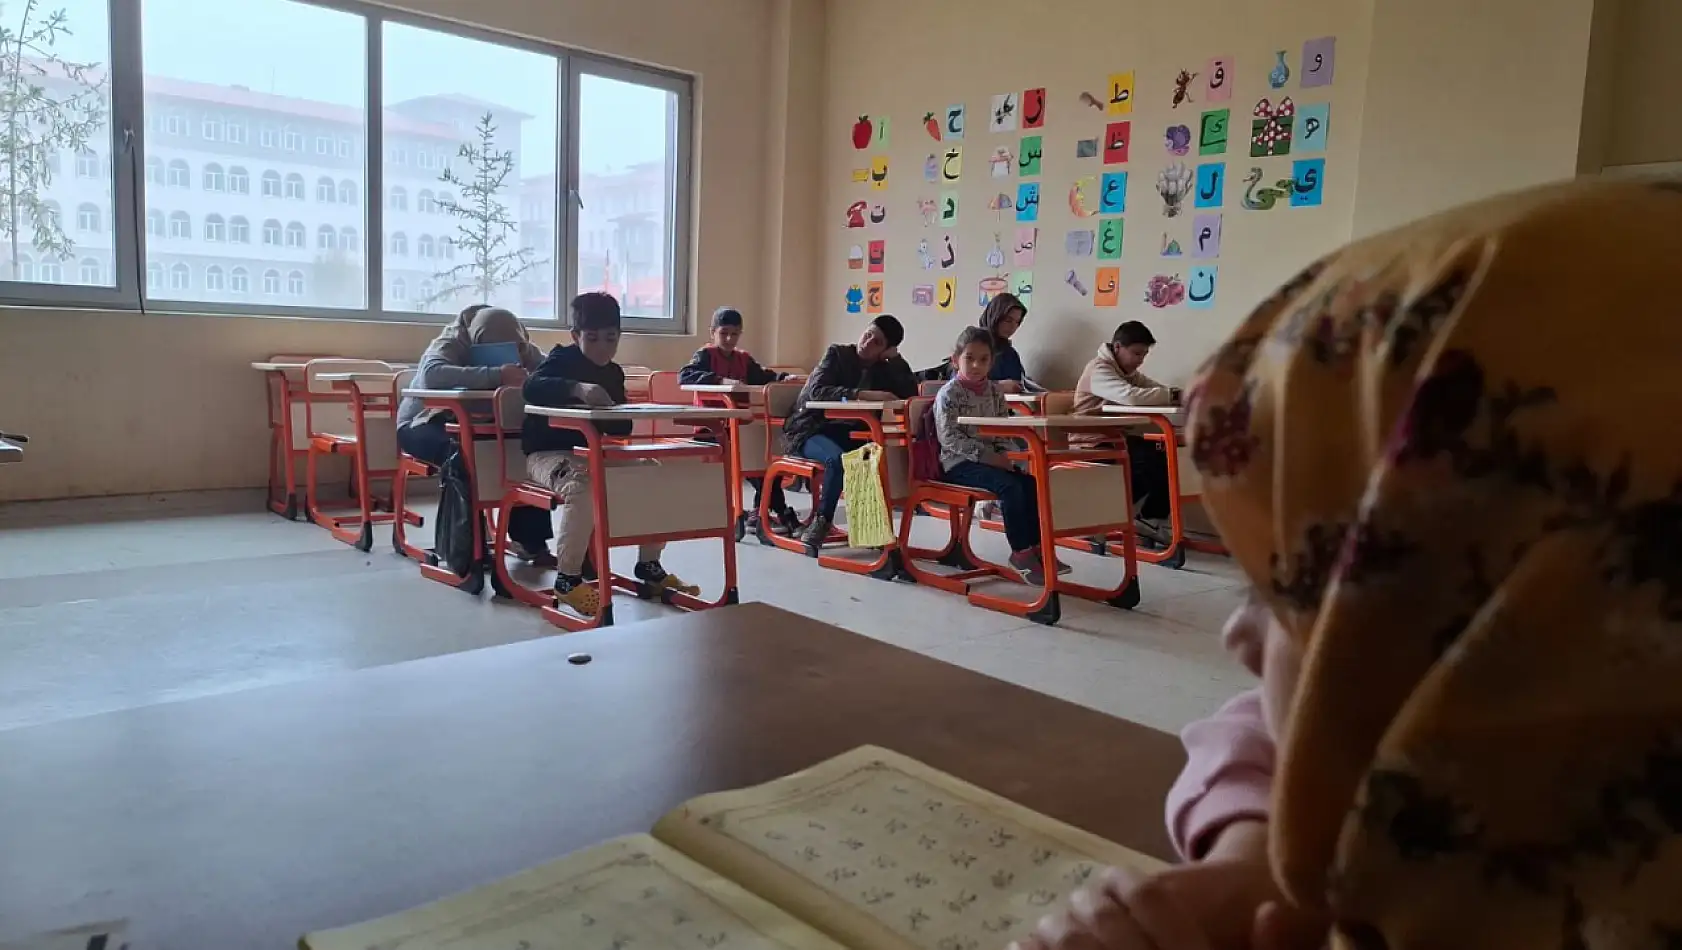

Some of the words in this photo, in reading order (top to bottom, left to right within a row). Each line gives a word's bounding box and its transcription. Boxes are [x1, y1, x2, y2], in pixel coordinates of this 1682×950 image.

[1209, 61, 1225, 90] ق
[1308, 53, 1323, 73] و
[1110, 82, 1130, 104] ط
[1024, 89, 1043, 125] ز
[947, 109, 963, 133] ح
[1199, 113, 1228, 148] ك
[1106, 131, 1126, 151] ظ
[943, 147, 960, 180] خ
[1018, 148, 1043, 168] س
[871, 164, 888, 187] ب
[1200, 170, 1219, 201] ل
[1015, 185, 1040, 212] ش
[1103, 179, 1121, 207] ع
[942, 197, 955, 220] د
[1013, 241, 1034, 254] ص
[1102, 220, 1117, 254] غ
[1198, 226, 1212, 252] م
[941, 234, 955, 269] ذ
[868, 286, 881, 308] ج
[938, 281, 952, 308] ر
[1011, 279, 1033, 298] ض
[1097, 275, 1117, 294] ف
[1188, 270, 1215, 302] ن
